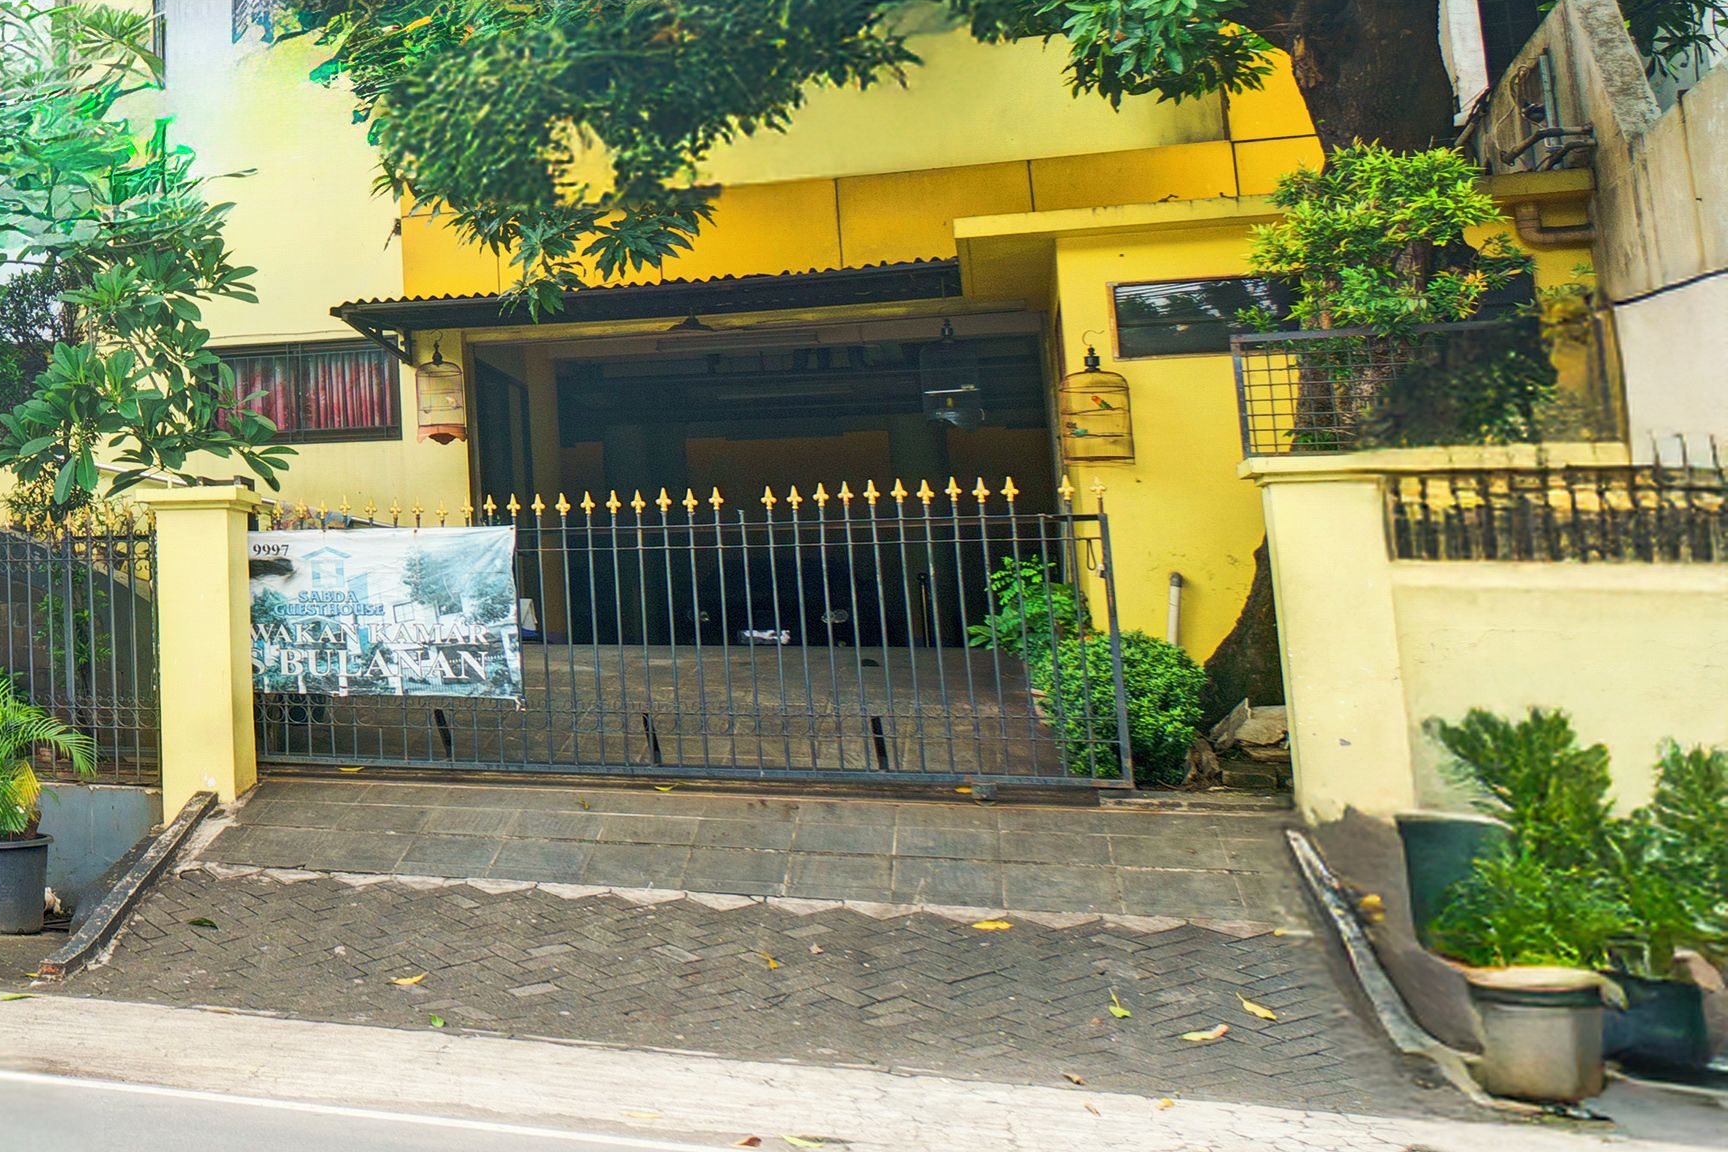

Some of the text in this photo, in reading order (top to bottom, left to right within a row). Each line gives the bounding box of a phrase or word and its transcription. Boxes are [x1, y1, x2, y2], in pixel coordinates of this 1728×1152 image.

[298, 591, 359, 603] SABDA
[273, 604, 385, 616] GUESTHOUSE
[368, 623, 489, 645] KAMAR
[279, 649, 488, 680] BULANAN
